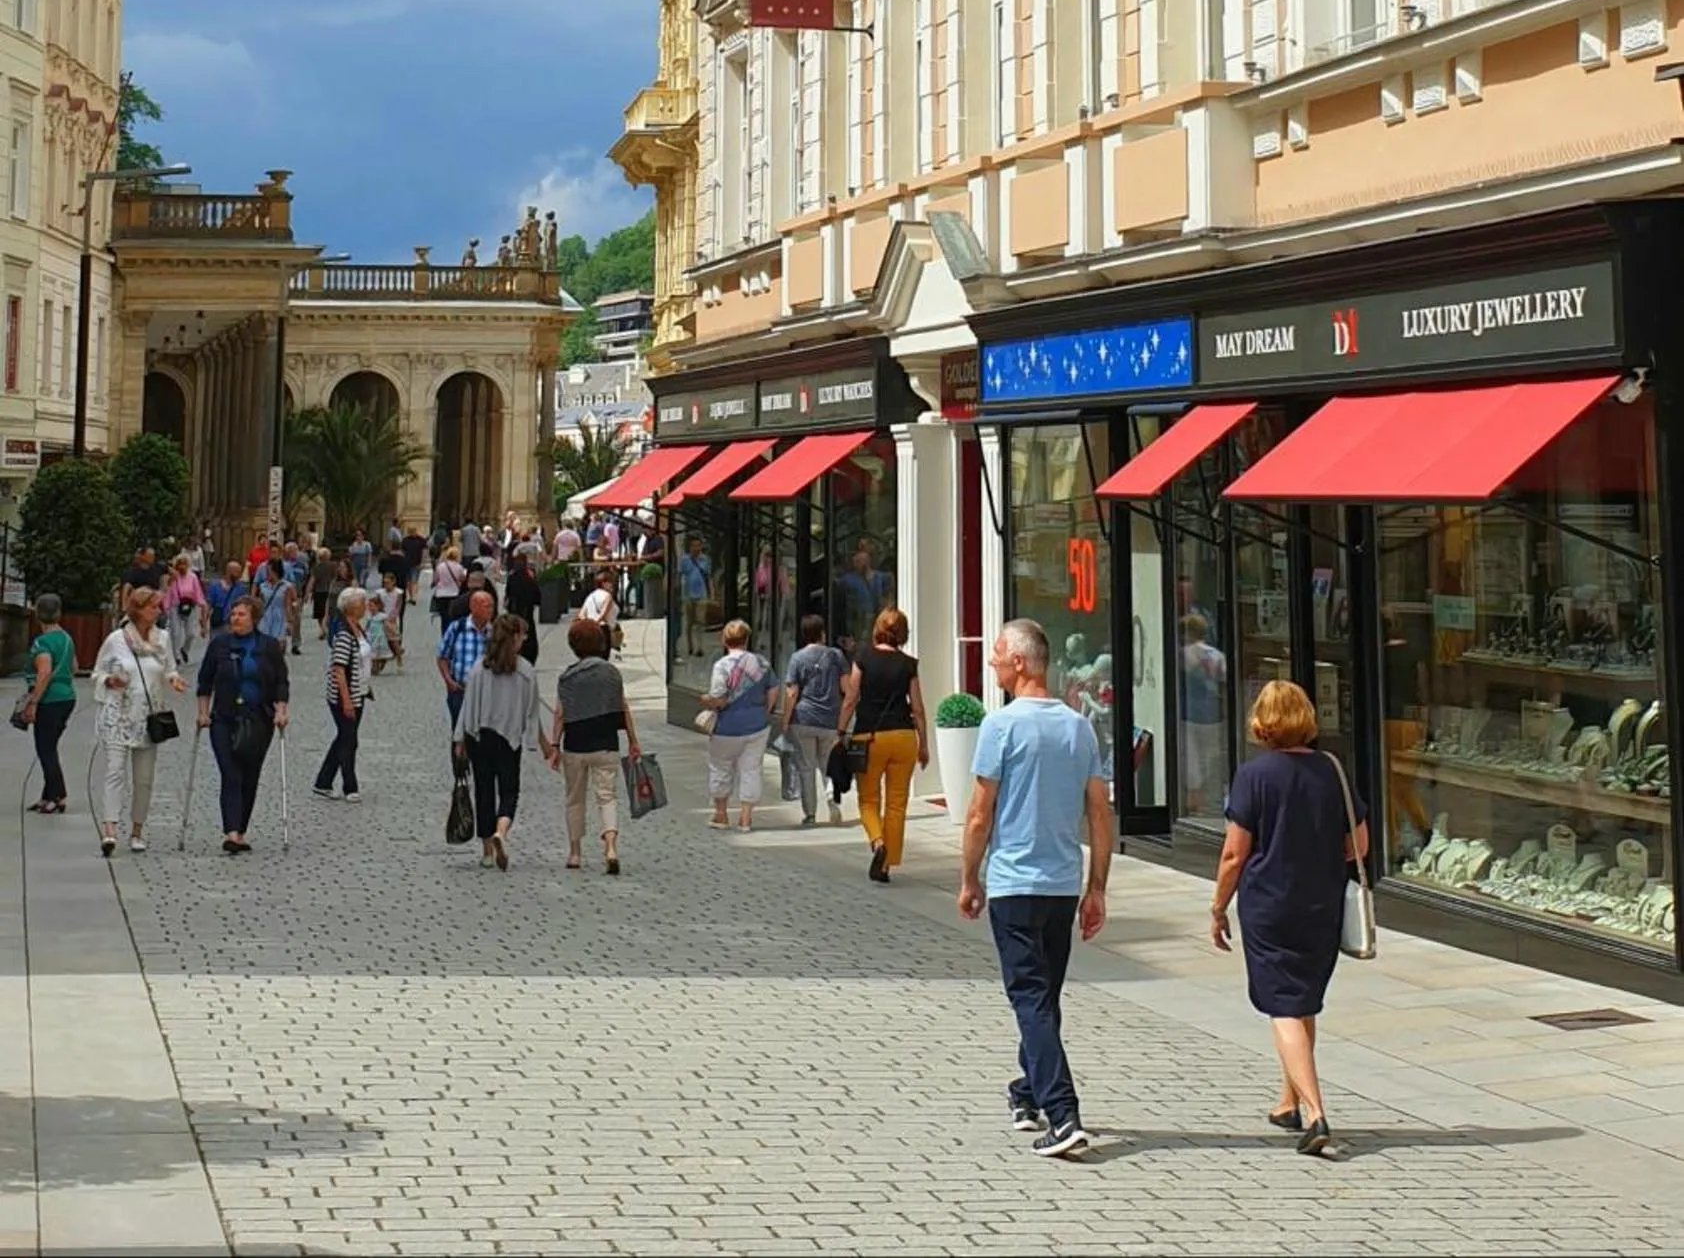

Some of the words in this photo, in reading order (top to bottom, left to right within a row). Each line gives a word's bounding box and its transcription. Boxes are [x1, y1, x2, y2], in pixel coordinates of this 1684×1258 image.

[1402, 300, 1473, 339] LUXURY
[1473, 287, 1587, 336] JEWELLERY
[1215, 333, 1242, 358] MAY
[1245, 326, 1295, 355] DREAM
[944, 361, 977, 385] GOLDE
[1068, 538, 1096, 612] 50
